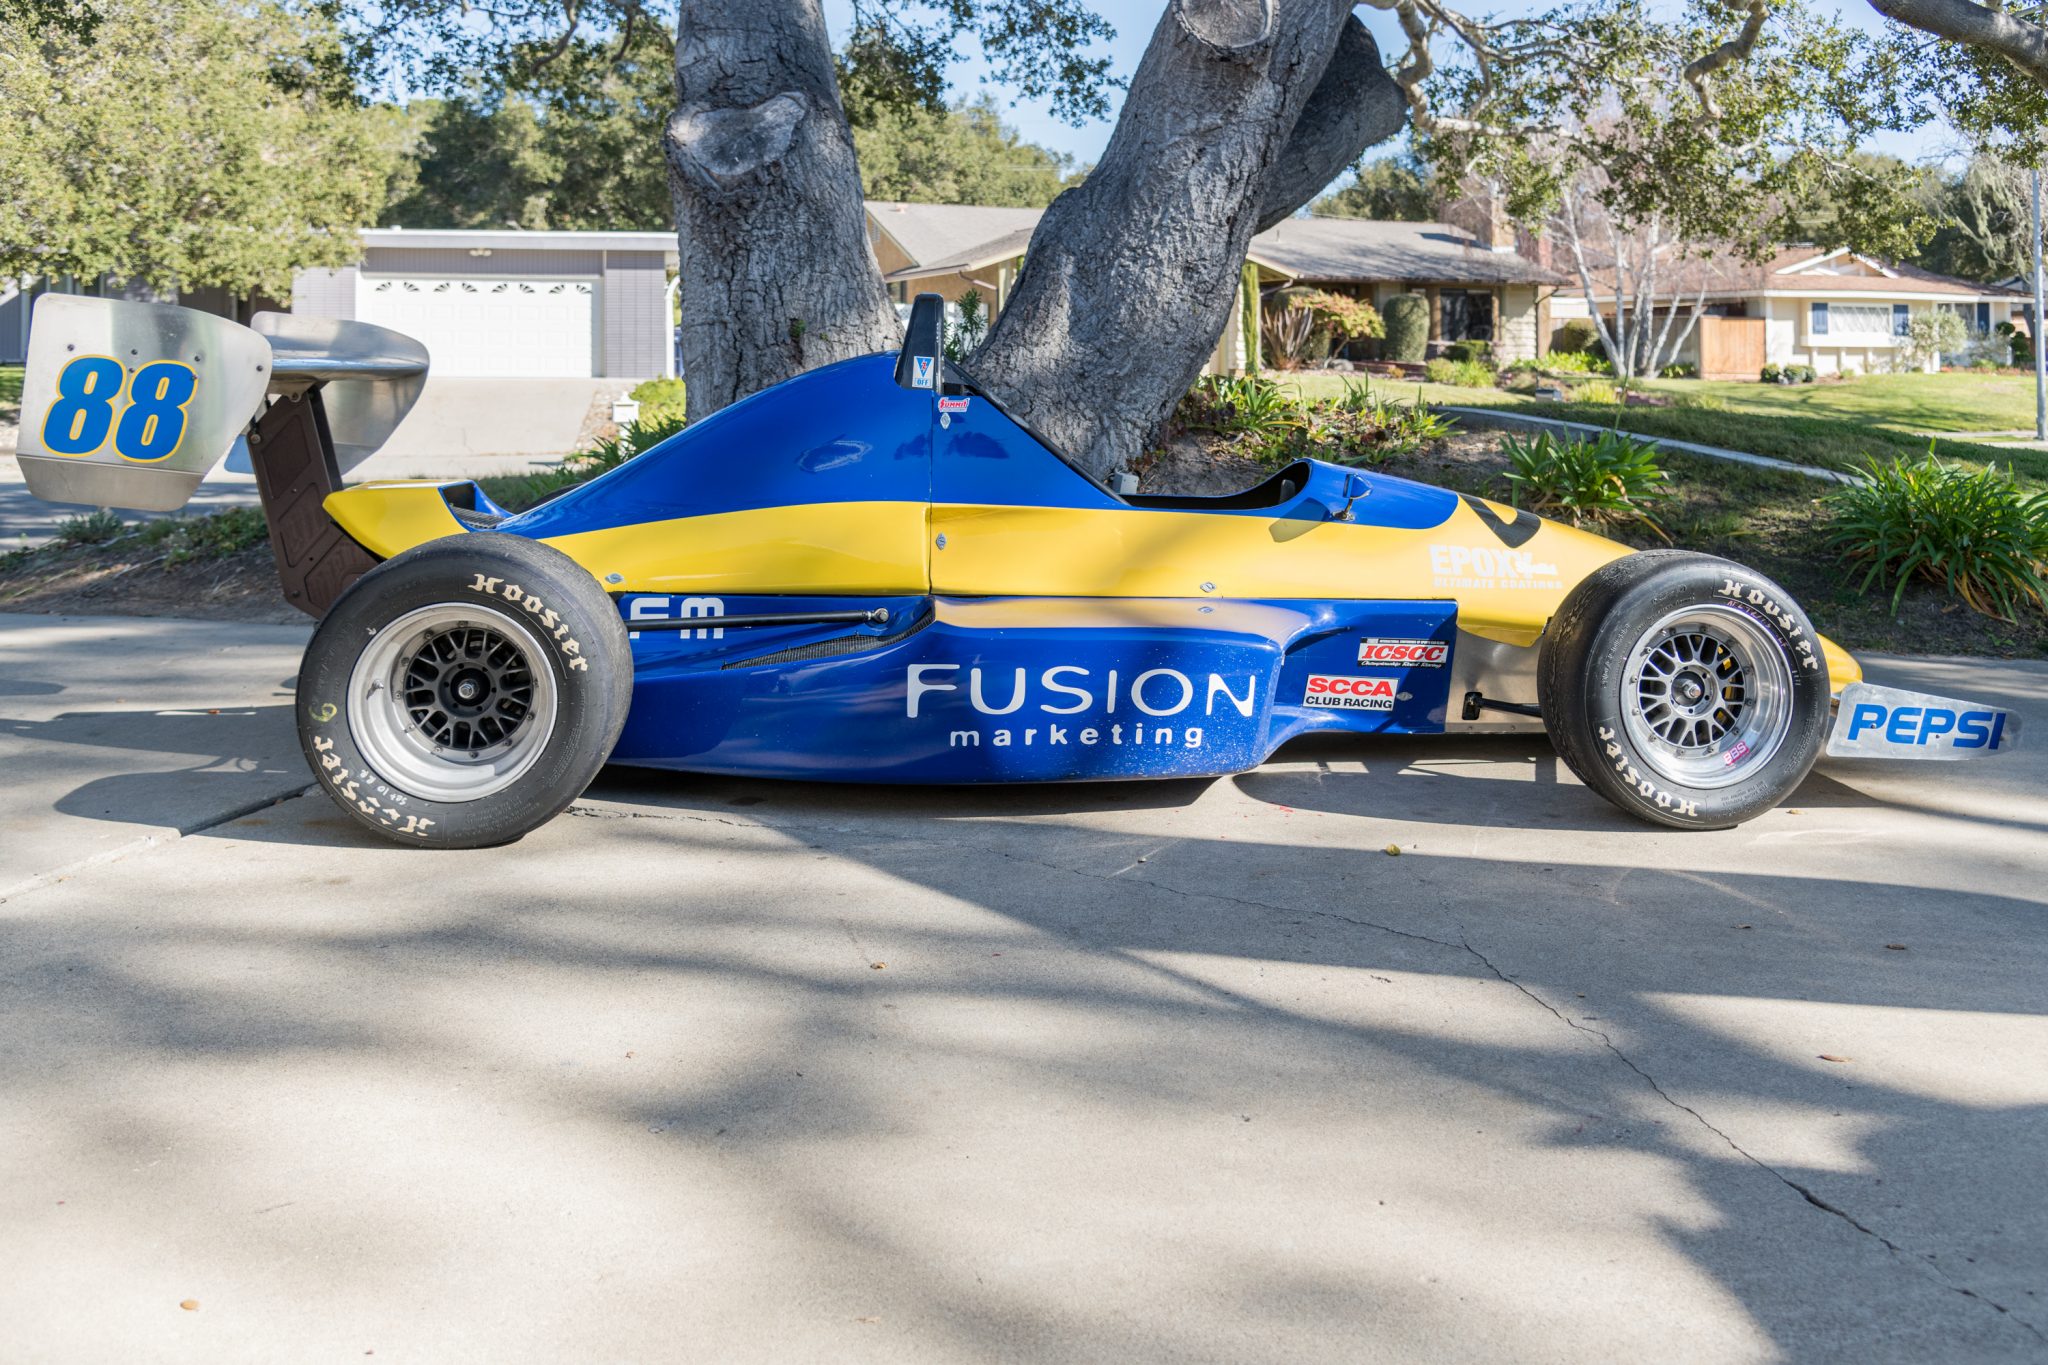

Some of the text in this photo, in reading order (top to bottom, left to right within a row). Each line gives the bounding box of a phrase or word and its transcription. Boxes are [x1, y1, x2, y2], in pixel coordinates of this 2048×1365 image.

[40, 354, 199, 463] 88
[467, 573, 588, 671] Hoosier
[1718, 580, 1818, 670] Hoosier
[1361, 645, 1445, 661] ICSCC
[906, 663, 1256, 719] FUSION
[1305, 696, 1393, 709] CLUB RACING
[1307, 677, 1393, 697] SCCA
[950, 722, 1203, 748] marketing
[1847, 704, 2007, 750] PEPSI
[1599, 726, 1698, 817] Hoosier
[1722, 742, 1748, 764] BBS
